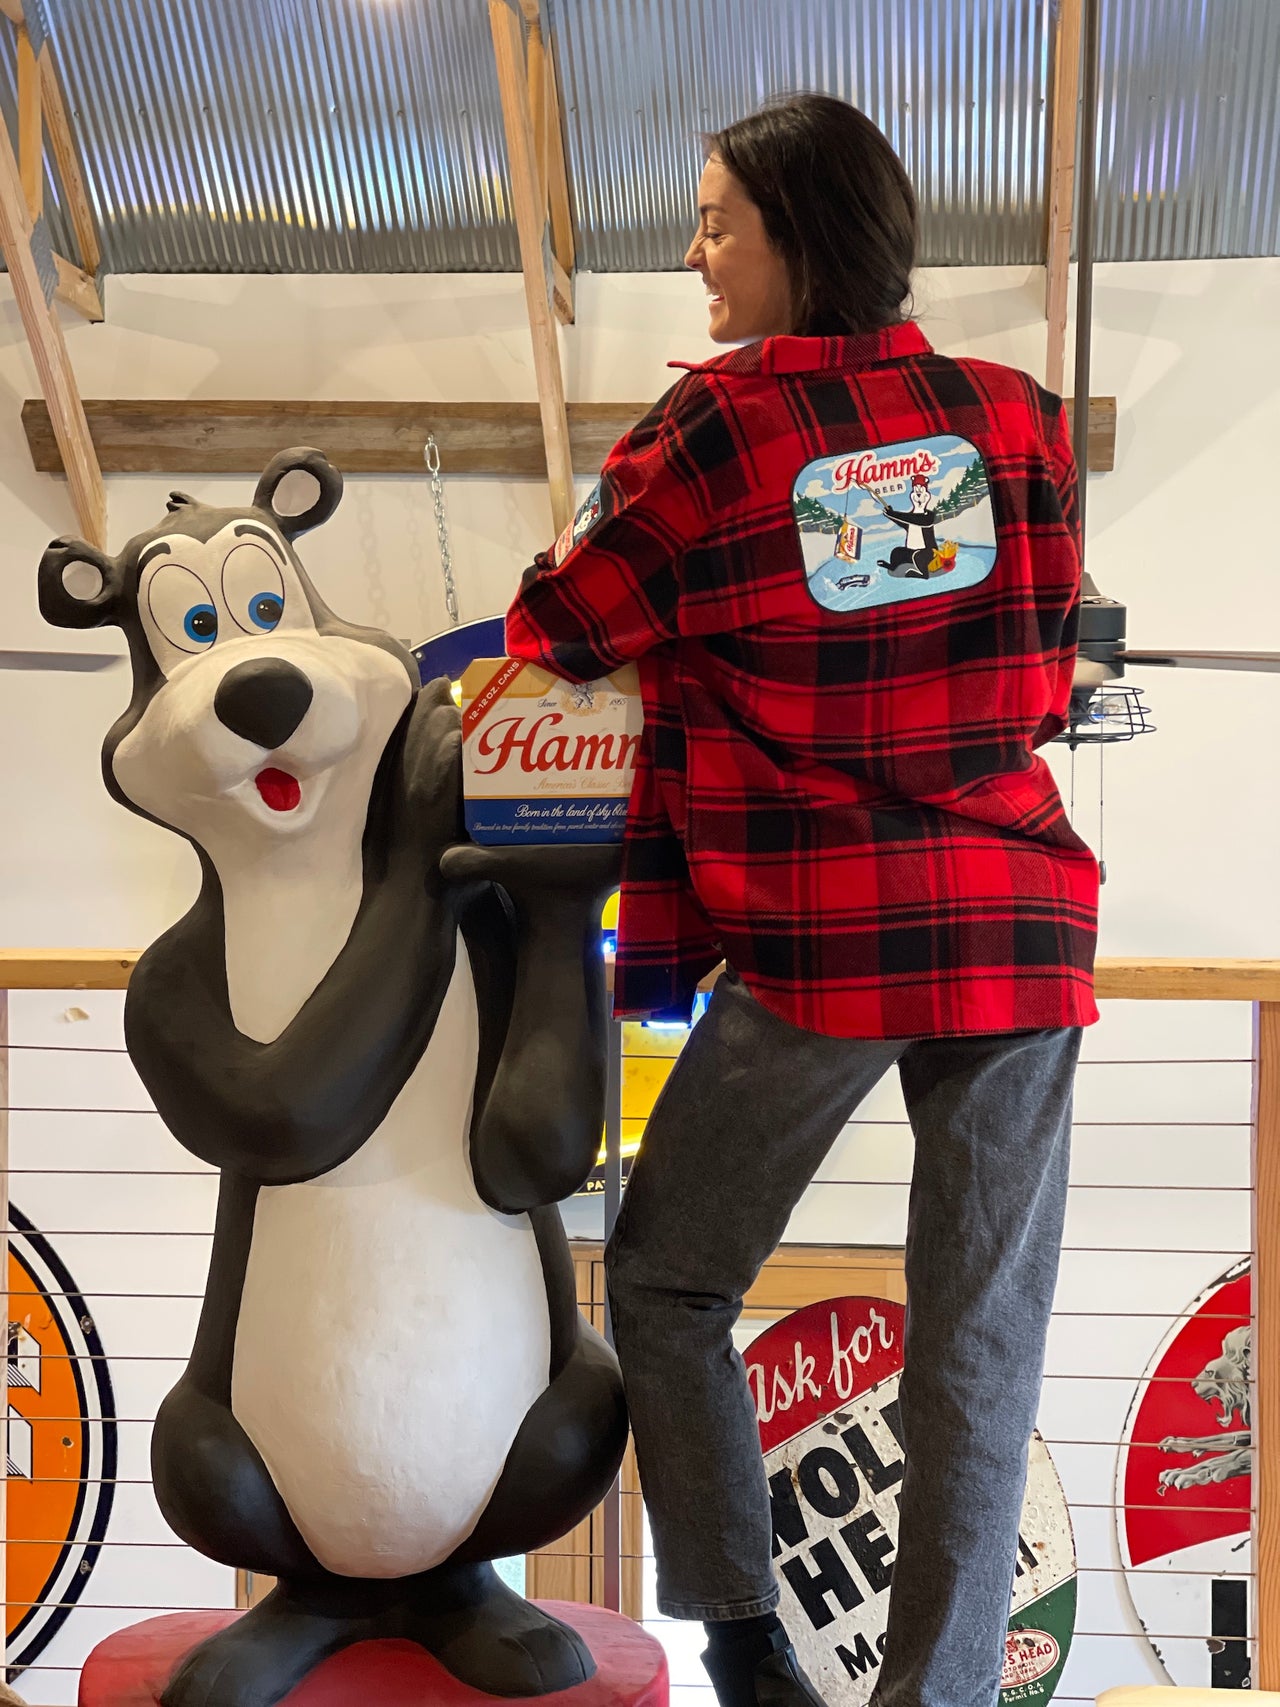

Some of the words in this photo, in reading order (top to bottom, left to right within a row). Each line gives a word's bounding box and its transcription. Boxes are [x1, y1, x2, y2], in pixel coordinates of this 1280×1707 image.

[836, 453, 935, 490] Hamm's
[875, 484, 903, 494] BEER
[498, 661, 520, 686] CANS
[474, 713, 642, 774] Hamm
[515, 804, 541, 817] Born
[541, 807, 550, 817] in
[550, 803, 564, 817] the
[565, 803, 587, 817] land
[586, 803, 601, 823] of
[596, 803, 611, 820] sky
[826, 1308, 893, 1399] for
[1018, 1642, 1053, 1661] HEAD
[1004, 1692, 1028, 1703] Permit
